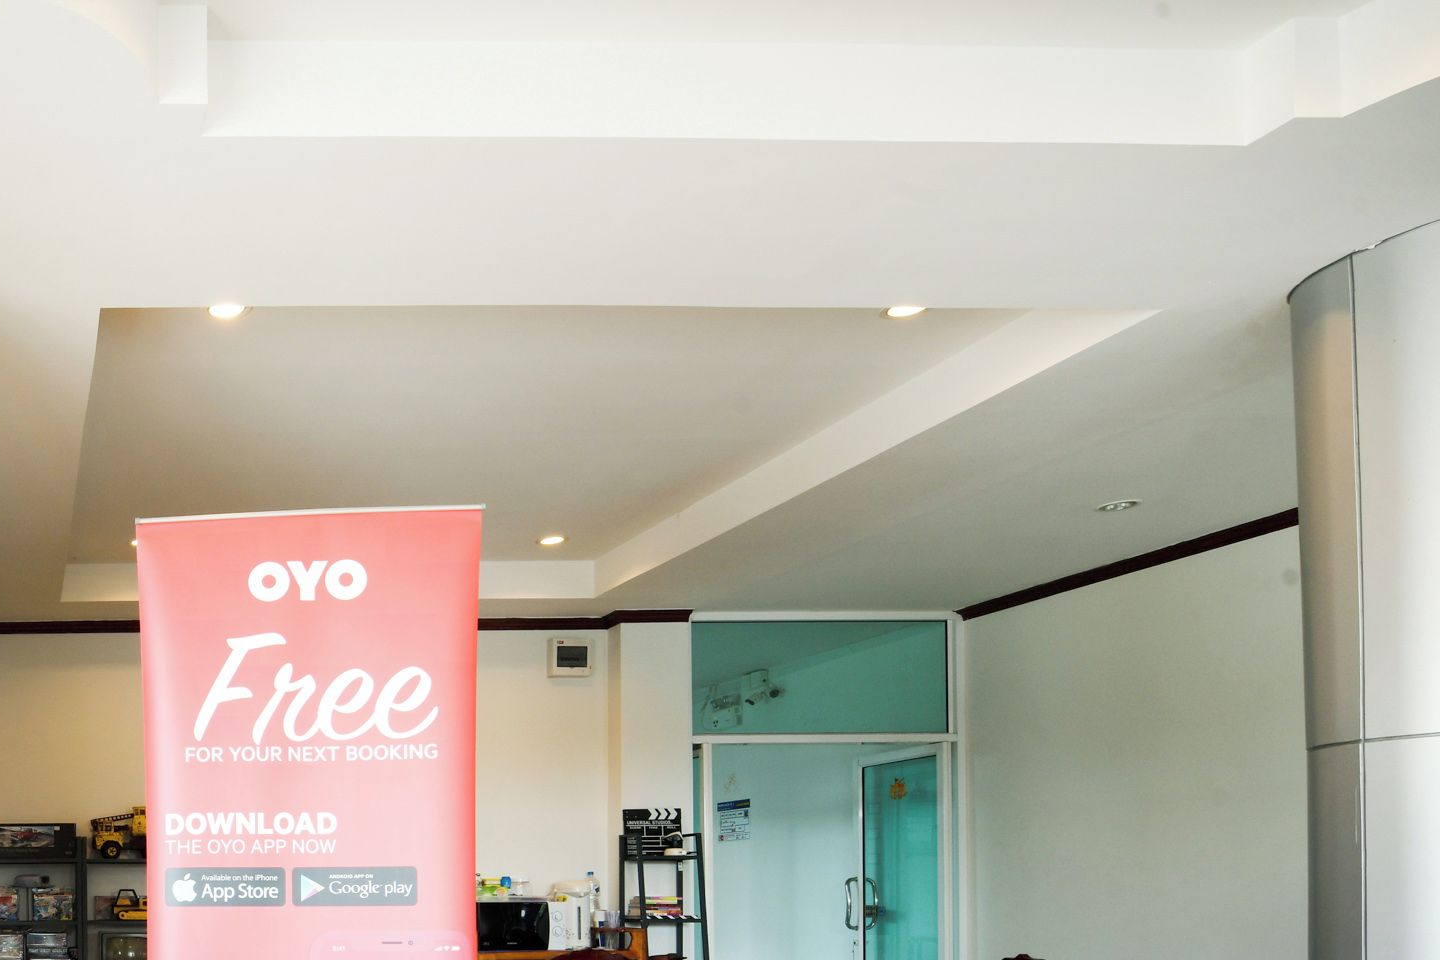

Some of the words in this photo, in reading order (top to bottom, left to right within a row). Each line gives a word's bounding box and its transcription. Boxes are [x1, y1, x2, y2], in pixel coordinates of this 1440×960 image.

[247, 558, 368, 602] OYO
[193, 631, 439, 746] Free
[185, 747, 224, 763] FOR
[229, 746, 282, 762] YOUR
[287, 745, 340, 762] NEXT
[345, 743, 438, 761] BOOKING
[165, 811, 338, 836] DOWNLOAD
[165, 839, 202, 855] THE
[206, 839, 245, 855] OYO
[250, 838, 286, 854] APP
[291, 838, 337, 854] NOW
[201, 874, 232, 882] Available
[254, 873, 278, 881] iPhone
[201, 883, 235, 902] App
[237, 883, 279, 899] Store
[328, 880, 380, 899] Google
[384, 881, 413, 896] play
